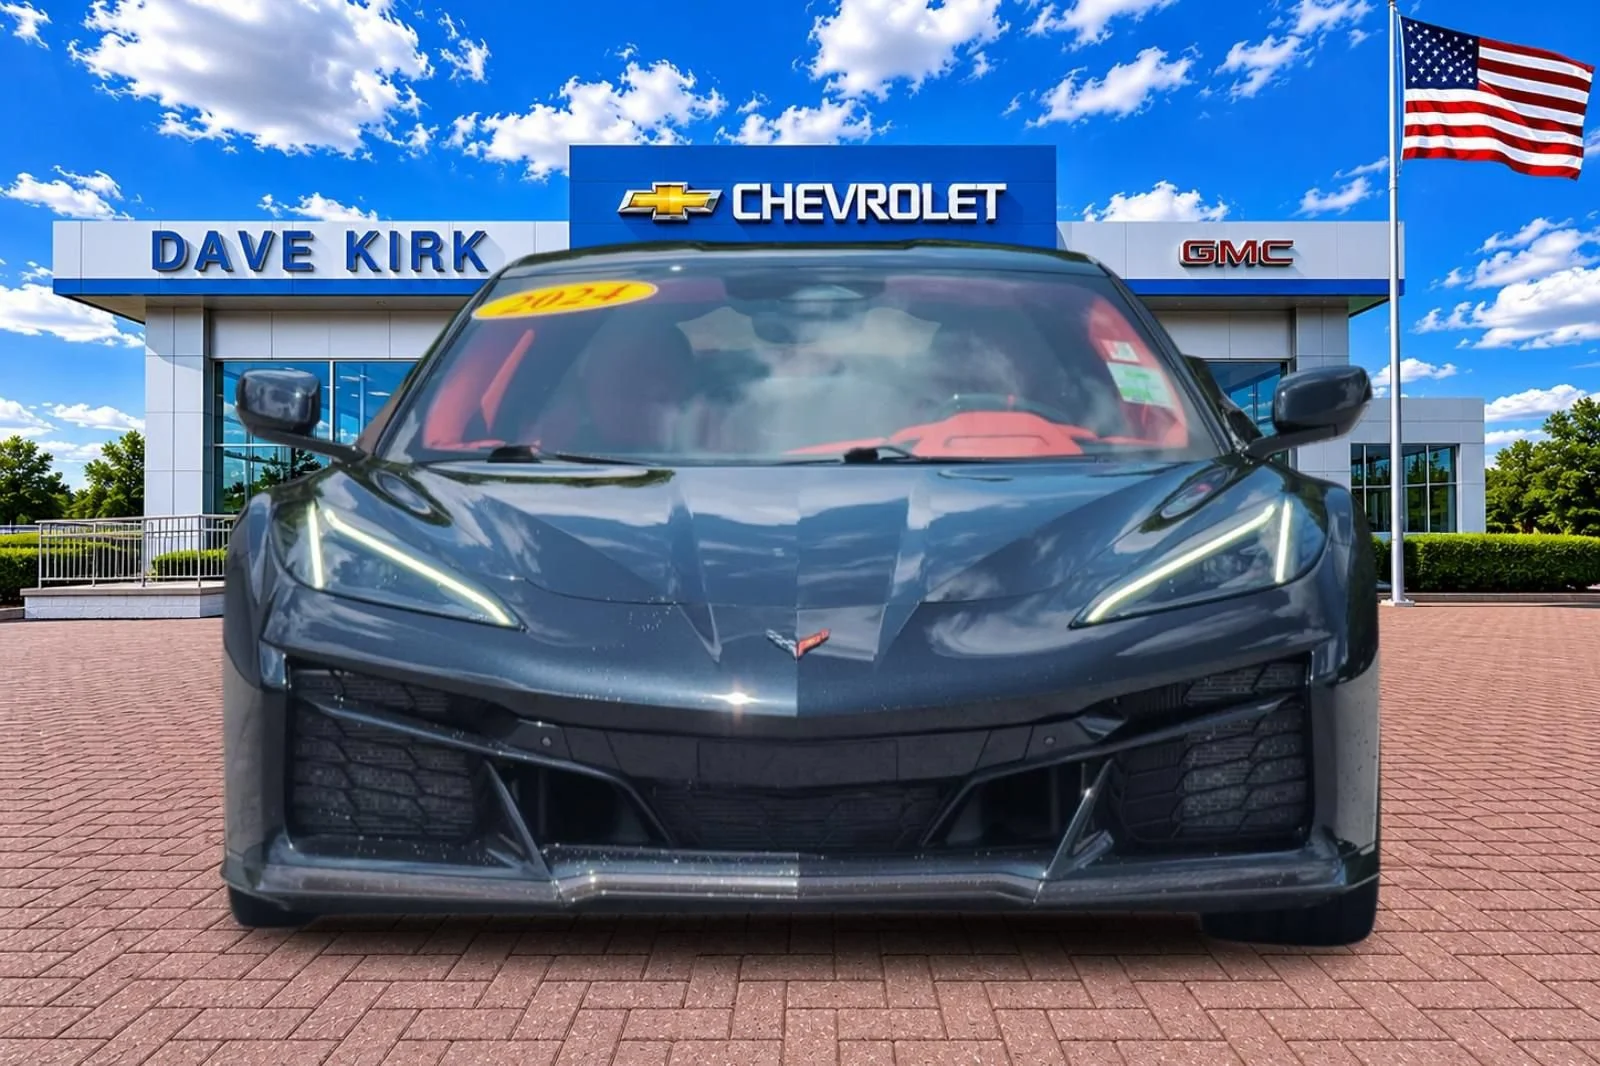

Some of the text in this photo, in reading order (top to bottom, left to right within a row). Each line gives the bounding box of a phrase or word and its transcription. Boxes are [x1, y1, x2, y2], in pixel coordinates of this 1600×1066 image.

[732, 182, 1006, 222] CHEVROLET
[151, 229, 489, 272] DAVE KIRK
[1179, 239, 1294, 267] GMC
[498, 284, 631, 316] 2024
